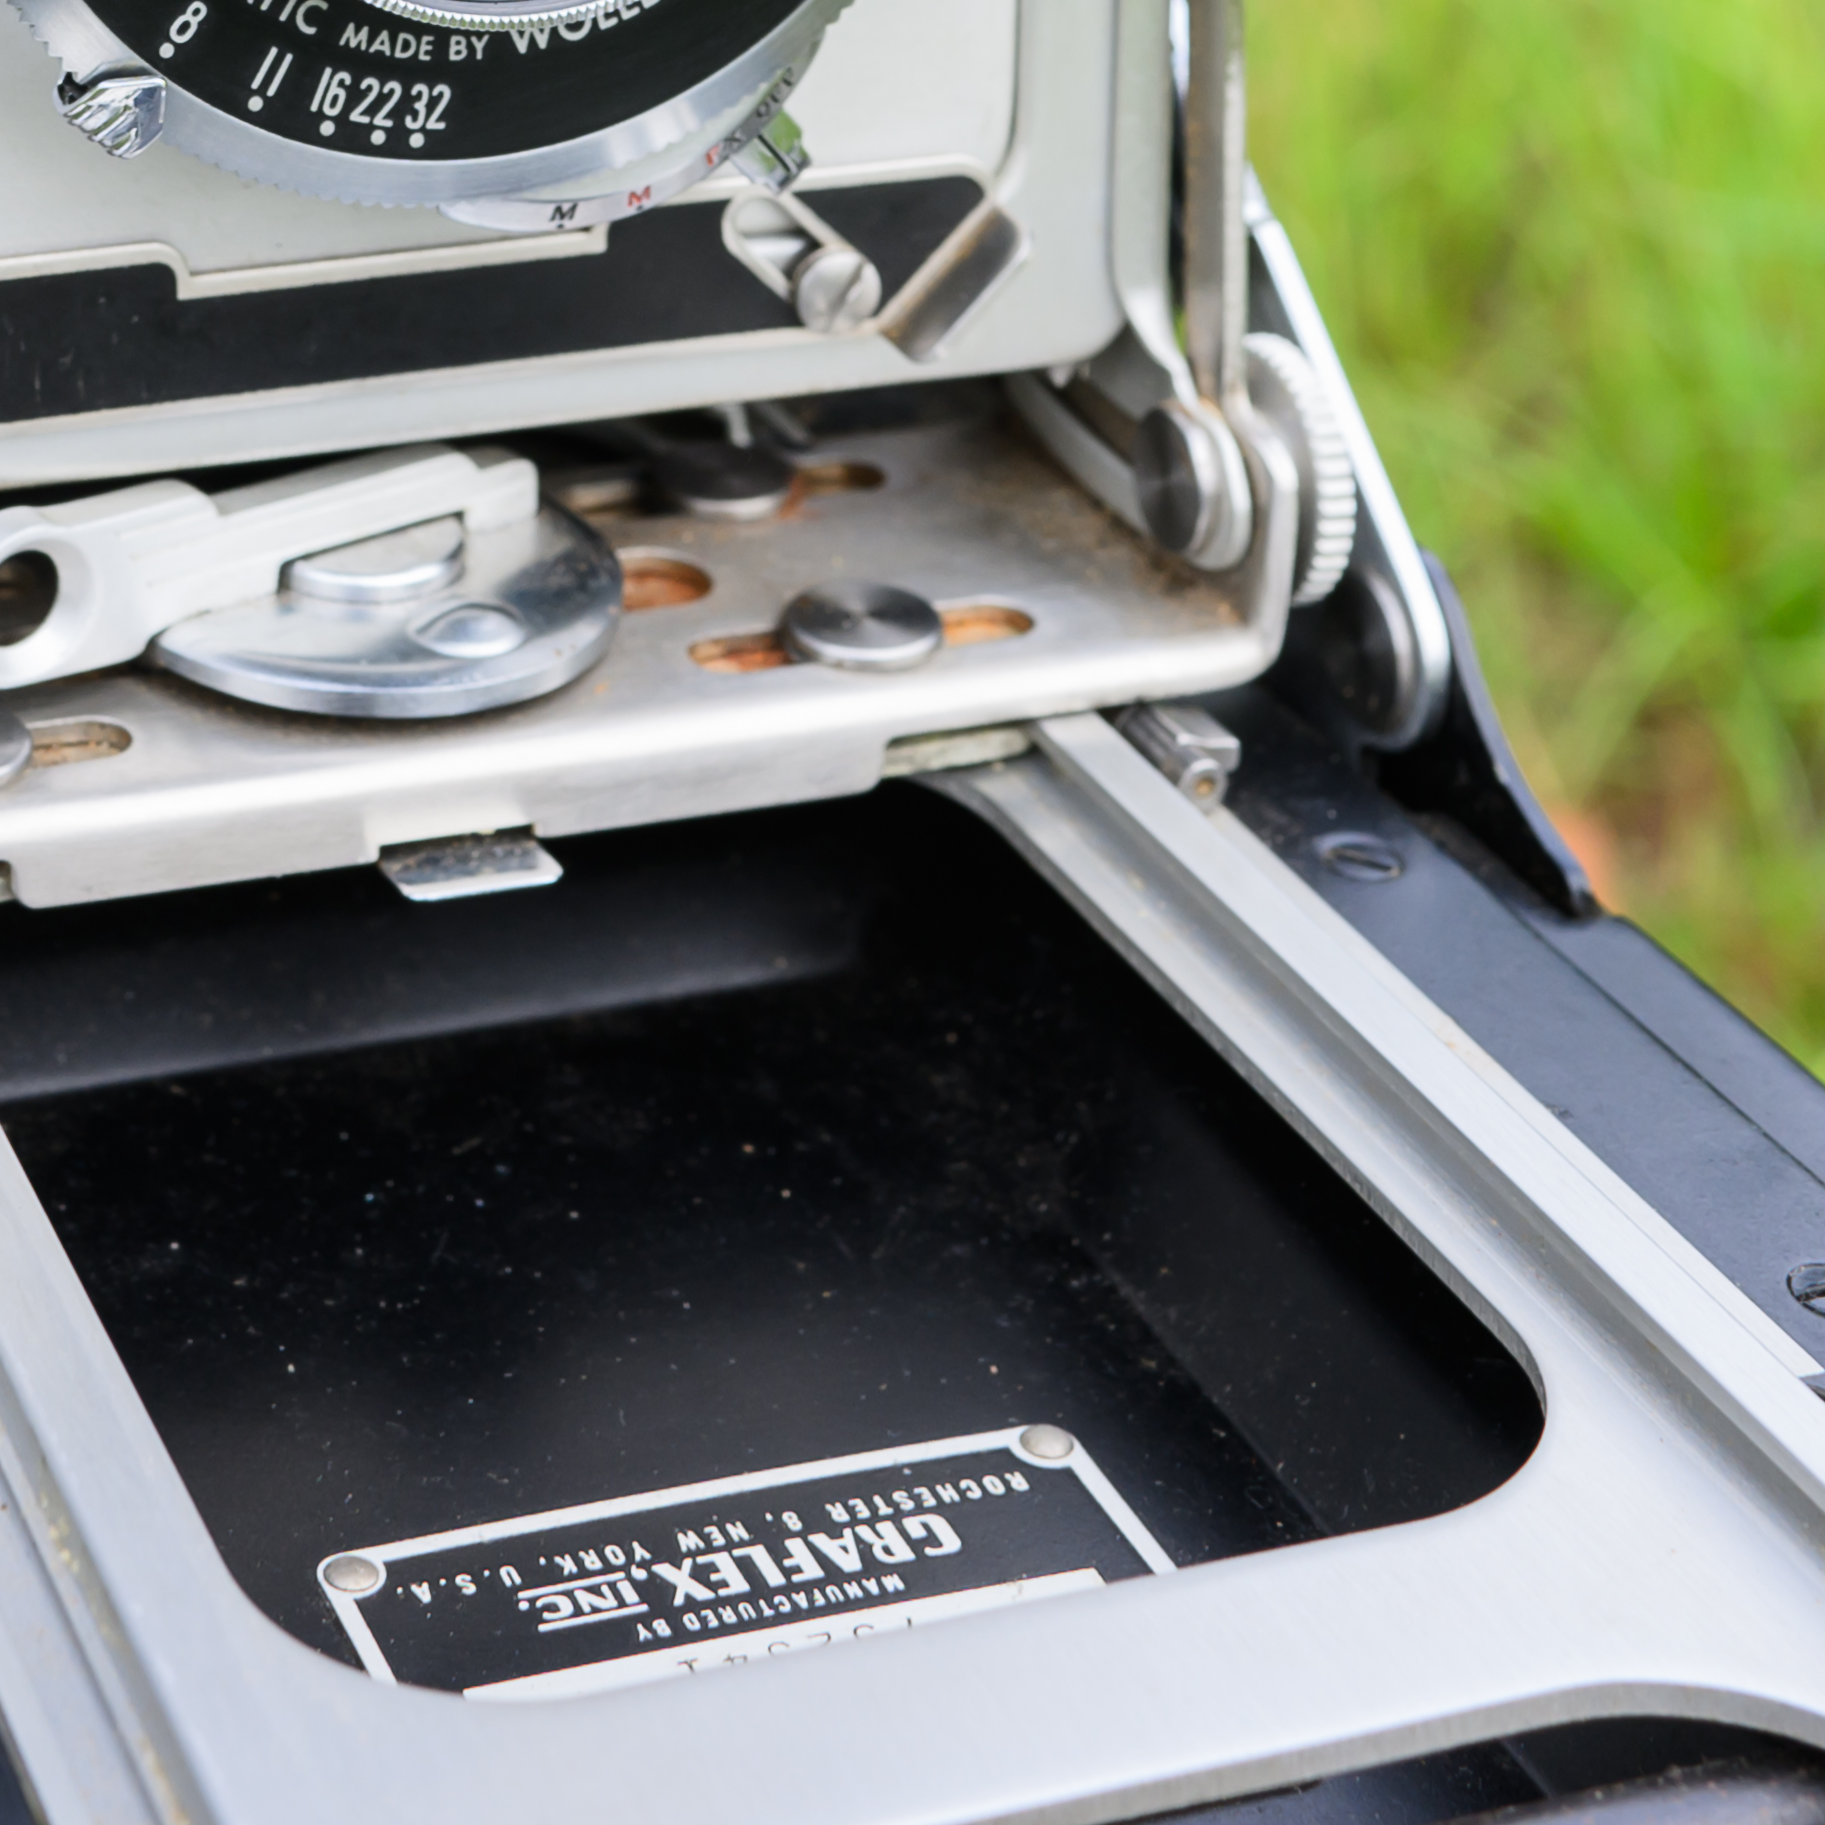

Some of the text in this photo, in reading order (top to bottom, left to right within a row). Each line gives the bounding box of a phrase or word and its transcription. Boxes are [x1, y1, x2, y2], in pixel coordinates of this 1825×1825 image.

[338, 22, 435, 62] MADE
[448, 34, 490, 62] BY
[168, 0, 209, 45] 8
[250, 46, 295, 98] 11
[309, 66, 352, 119] 16
[349, 77, 405, 128] 22
[405, 83, 453, 131] 32
[549, 202, 578, 222] M
[627, 185, 652, 206] M
[825, 1471, 1031, 1523] ROCHESTER
[677, 1520, 751, 1554] NEW
[517, 1512, 963, 1622] GRAFLEX, INC.
[539, 1540, 651, 1577] YORK,
[396, 1565, 522, 1605] U.S.A.
[636, 1573, 906, 1642] MANUFACTURED BY
